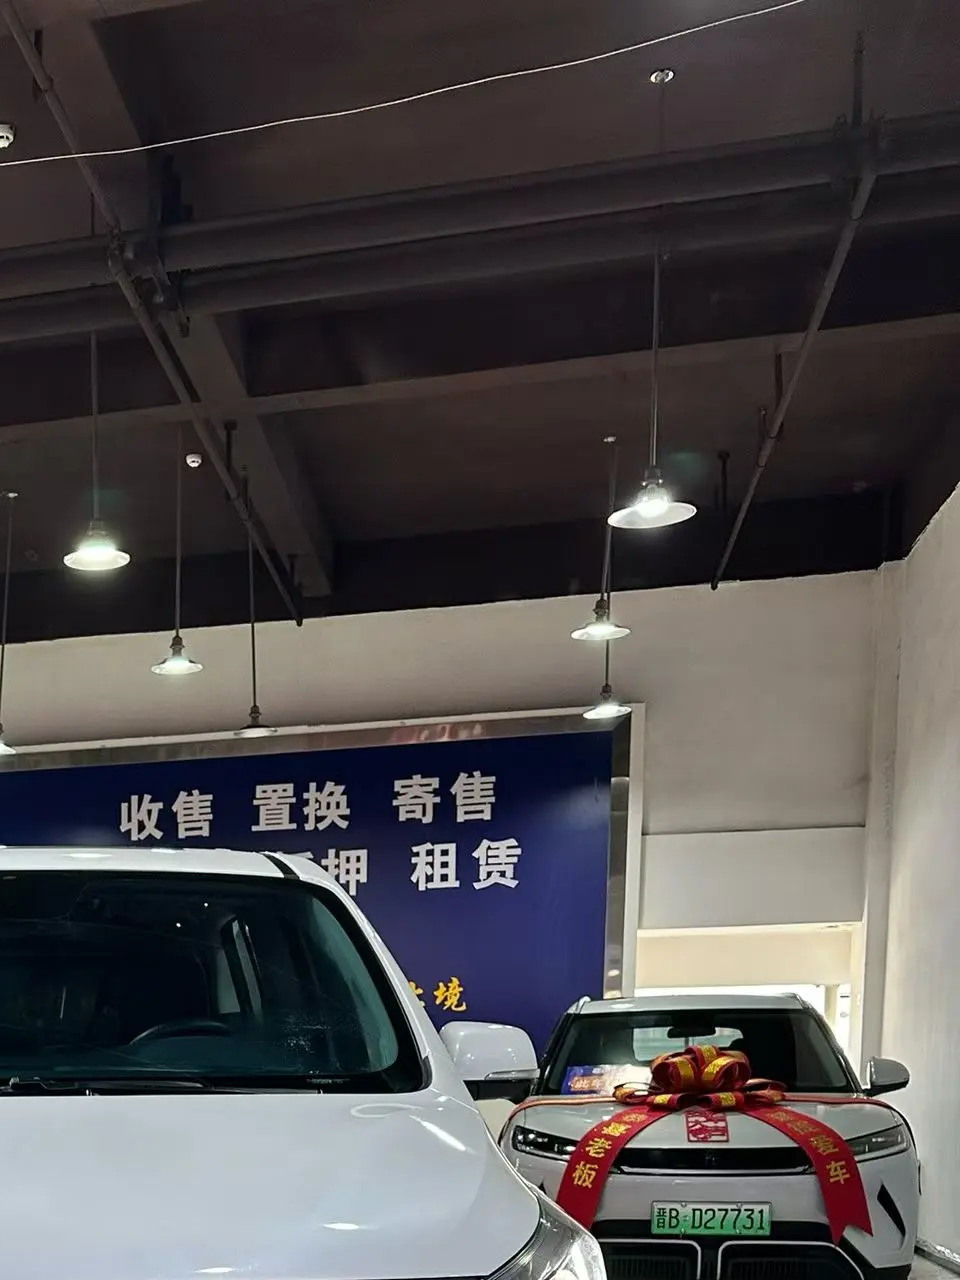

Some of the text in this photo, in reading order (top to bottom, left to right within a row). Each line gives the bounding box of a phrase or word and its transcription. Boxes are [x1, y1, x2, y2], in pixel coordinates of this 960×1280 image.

[119, 770, 497, 841] 收售 置换 寄售
[289, 838, 523, 896] 押 租赁
